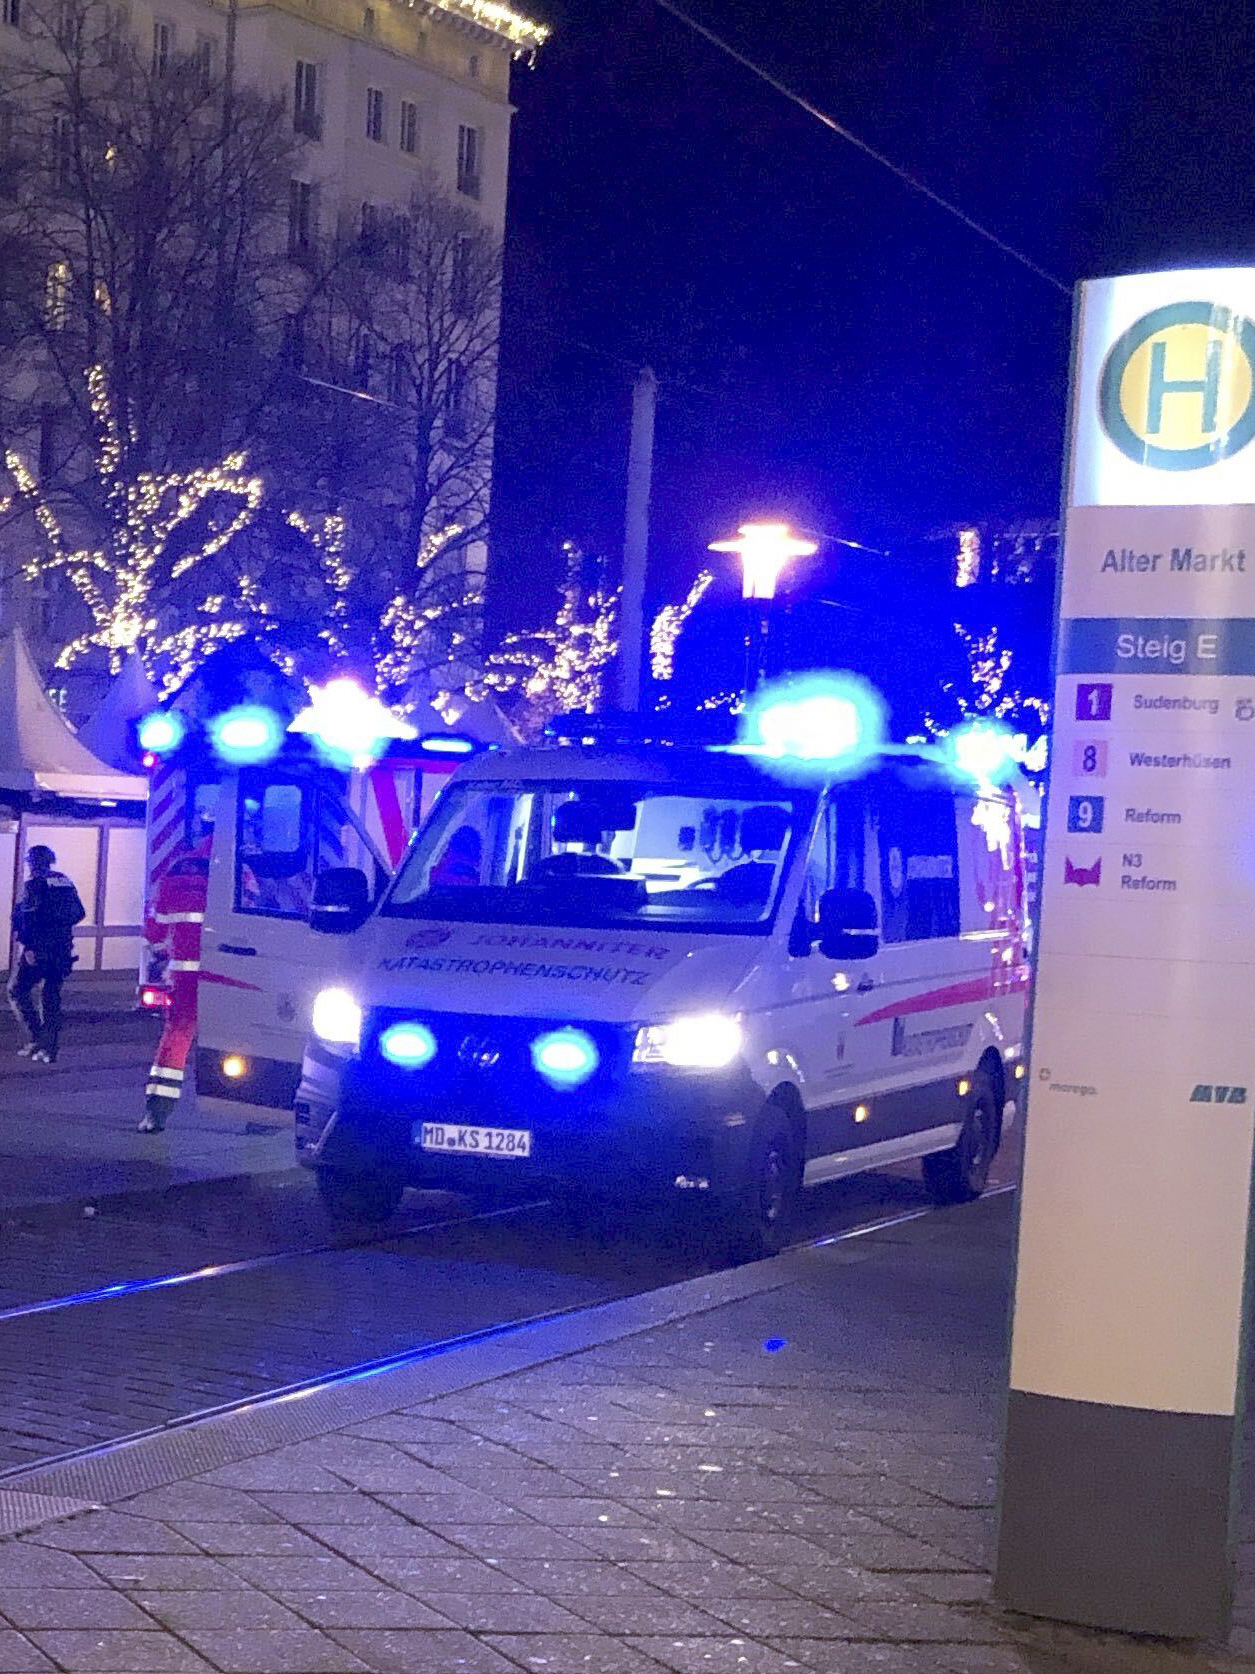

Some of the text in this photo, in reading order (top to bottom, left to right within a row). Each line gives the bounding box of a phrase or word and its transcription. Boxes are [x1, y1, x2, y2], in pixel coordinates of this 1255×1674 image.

[1101, 548, 1246, 572] Alter Markt
[1117, 634, 1219, 664] Steig E
[1088, 688, 1219, 716] 1 Sudenburg
[1082, 745, 1097, 772] 8
[1078, 801, 1181, 828] 9 Reform
[1122, 853, 1142, 867] N3
[1121, 875, 1176, 891] Reform
[423, 1125, 527, 1154] MD KS 1284
